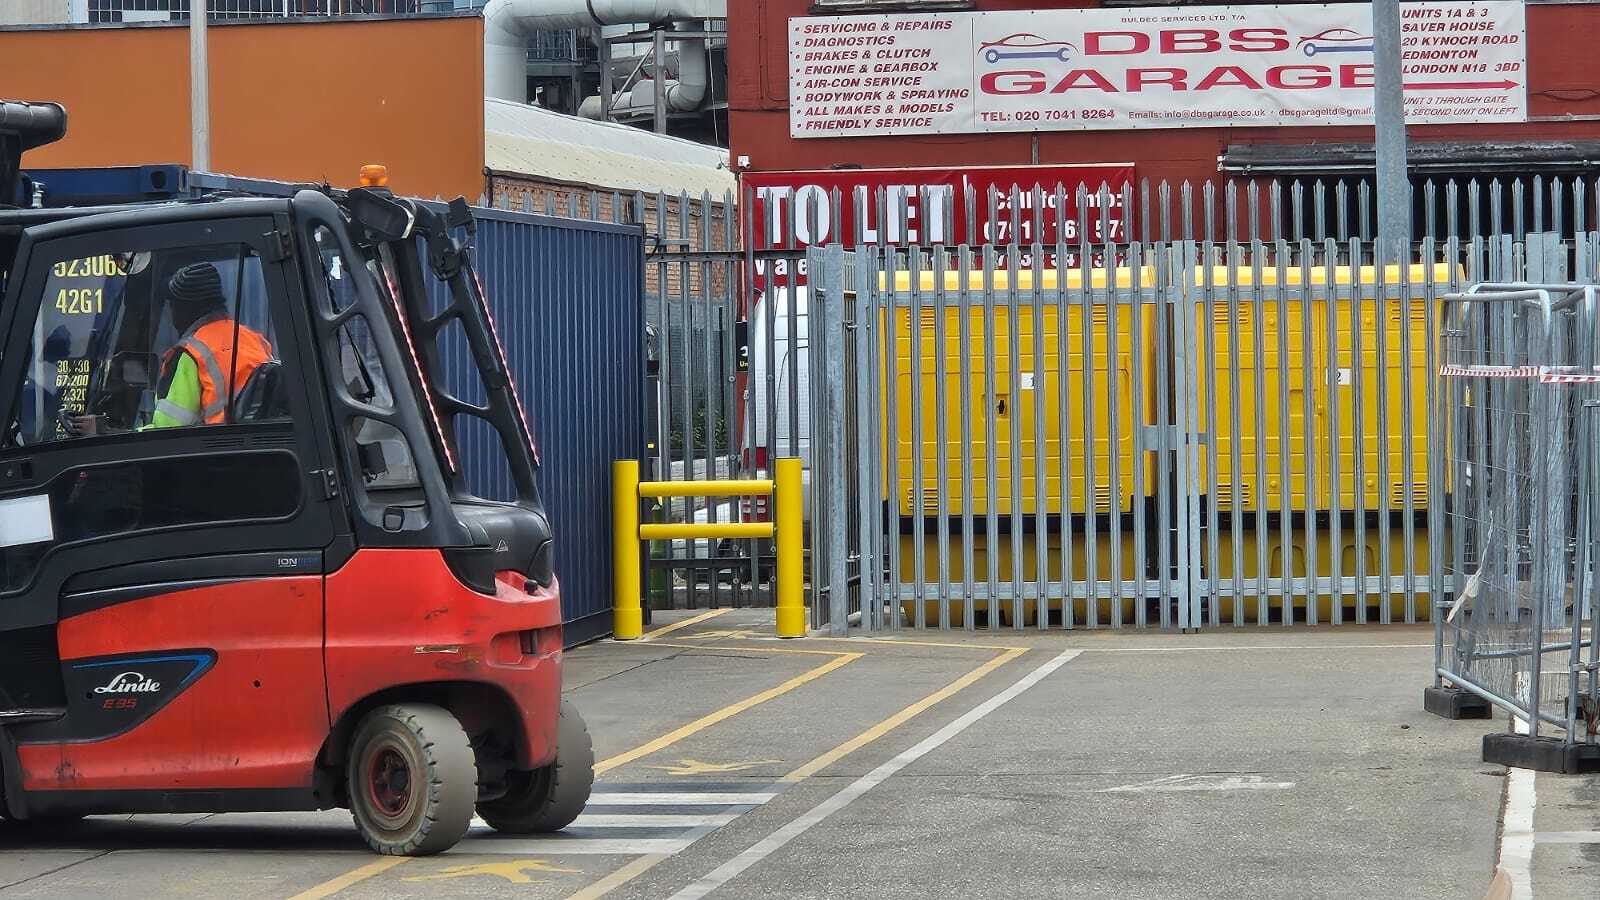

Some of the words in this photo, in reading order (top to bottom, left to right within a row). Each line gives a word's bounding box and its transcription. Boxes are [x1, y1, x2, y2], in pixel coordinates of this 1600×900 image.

[1401, 8, 1442, 18] UNITS
[1446, 8, 1462, 18] 1A
[1466, 8, 1475, 17] &
[1480, 8, 1489, 17] 3
[803, 22, 876, 34] SERVICING
[880, 22, 890, 31] &
[894, 20, 953, 31] REPAIRS
[1401, 22, 1445, 32] SAVER
[1449, 21, 1495, 31] HOUSE
[803, 35, 896, 47] DIAGNOSTICS
[1083, 28, 1290, 56] DBS
[1401, 37, 1418, 46] 20
[1421, 35, 1478, 46] KYNOCH
[1481, 34, 1519, 44] ROAD
[804, 50, 858, 61] BRAKES
[861, 50, 871, 59] &
[876, 48, 931, 59] CLUTCH
[1402, 49, 1478, 59] EDMONTON
[804, 64, 855, 75] ENGINE
[859, 64, 868, 73] &
[873, 62, 939, 73] GEARBOX
[1402, 63, 1458, 74] LONDON
[1461, 63, 1487, 73] N18
[1494, 62, 1520, 72] 3BD
[804, 78, 861, 89] AIR-CON
[863, 76, 922, 87] SERVICE
[979, 64, 1376, 95] GARAGE
[805, 91, 883, 103] BODYWORK
[886, 91, 896, 100] &
[900, 89, 969, 100] SPRAYING
[1403, 96, 1424, 105] UNIT
[1426, 96, 1433, 105] 3
[1435, 95, 1481, 104] THROUGH
[1484, 95, 1509, 104] GATE
[804, 106, 829, 116] ALL
[833, 104, 881, 116] MAKES
[885, 105, 894, 114] &
[899, 103, 954, 114] MODELS
[981, 111, 1011, 121] TEL:
[1015, 110, 1041, 121] 020
[1045, 110, 1076, 120] 7041
[1081, 109, 1115, 120] 8264
[1128, 111, 1162, 119] Emails:
[1164, 108, 1266, 120] info@dbsgarage.co.uk
[1278, 106, 1375, 118] dbsgarageltd@gmail.
[1411, 107, 1452, 117] SECOND
[1453, 107, 1477, 116] UNIT
[1477, 107, 1493, 115] ON
[1493, 106, 1518, 115] LEFT
[806, 118, 872, 131] FRIENDLY
[875, 117, 933, 129] SERVICE
[756, 185, 830, 244] TO
[855, 184, 954, 243] LET
[55, 288, 104, 315] 42G1
[277, 557, 298, 566] ION
[94, 671, 161, 694] Linde
